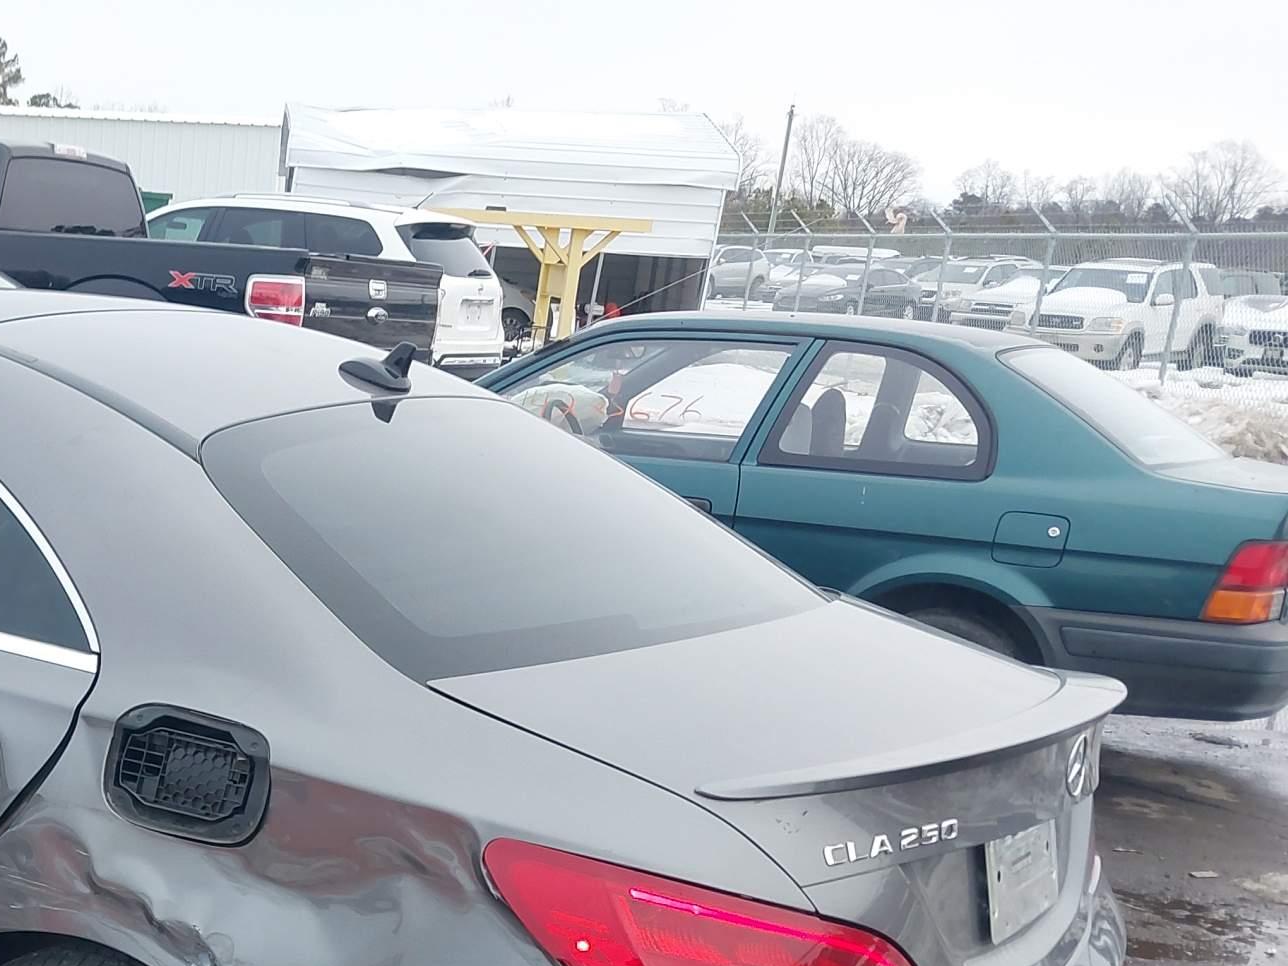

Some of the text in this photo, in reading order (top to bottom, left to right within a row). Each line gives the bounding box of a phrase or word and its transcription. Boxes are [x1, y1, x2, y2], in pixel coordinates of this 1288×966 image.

[168, 270, 238, 293] XTR
[823, 818, 959, 867] CLA 250
